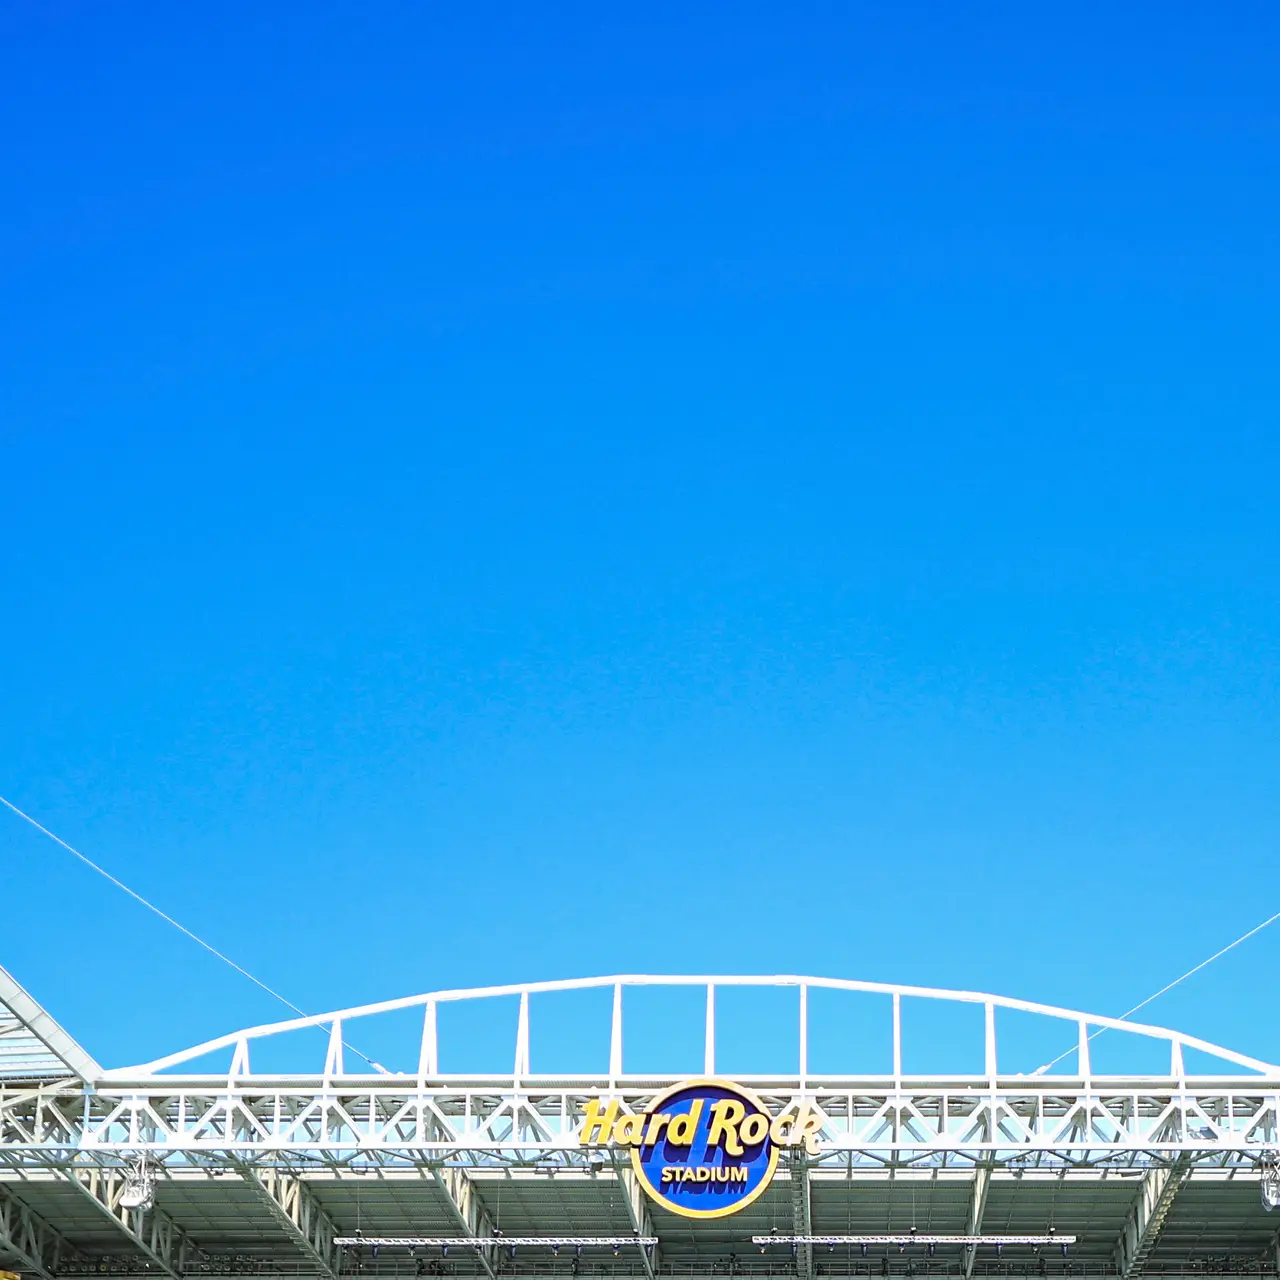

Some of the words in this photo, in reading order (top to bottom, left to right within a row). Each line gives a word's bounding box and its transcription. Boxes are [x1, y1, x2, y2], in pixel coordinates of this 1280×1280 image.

[578, 1097, 704, 1145] Hard
[707, 1098, 822, 1155] Rock
[661, 1166, 748, 1183] STADIUM
